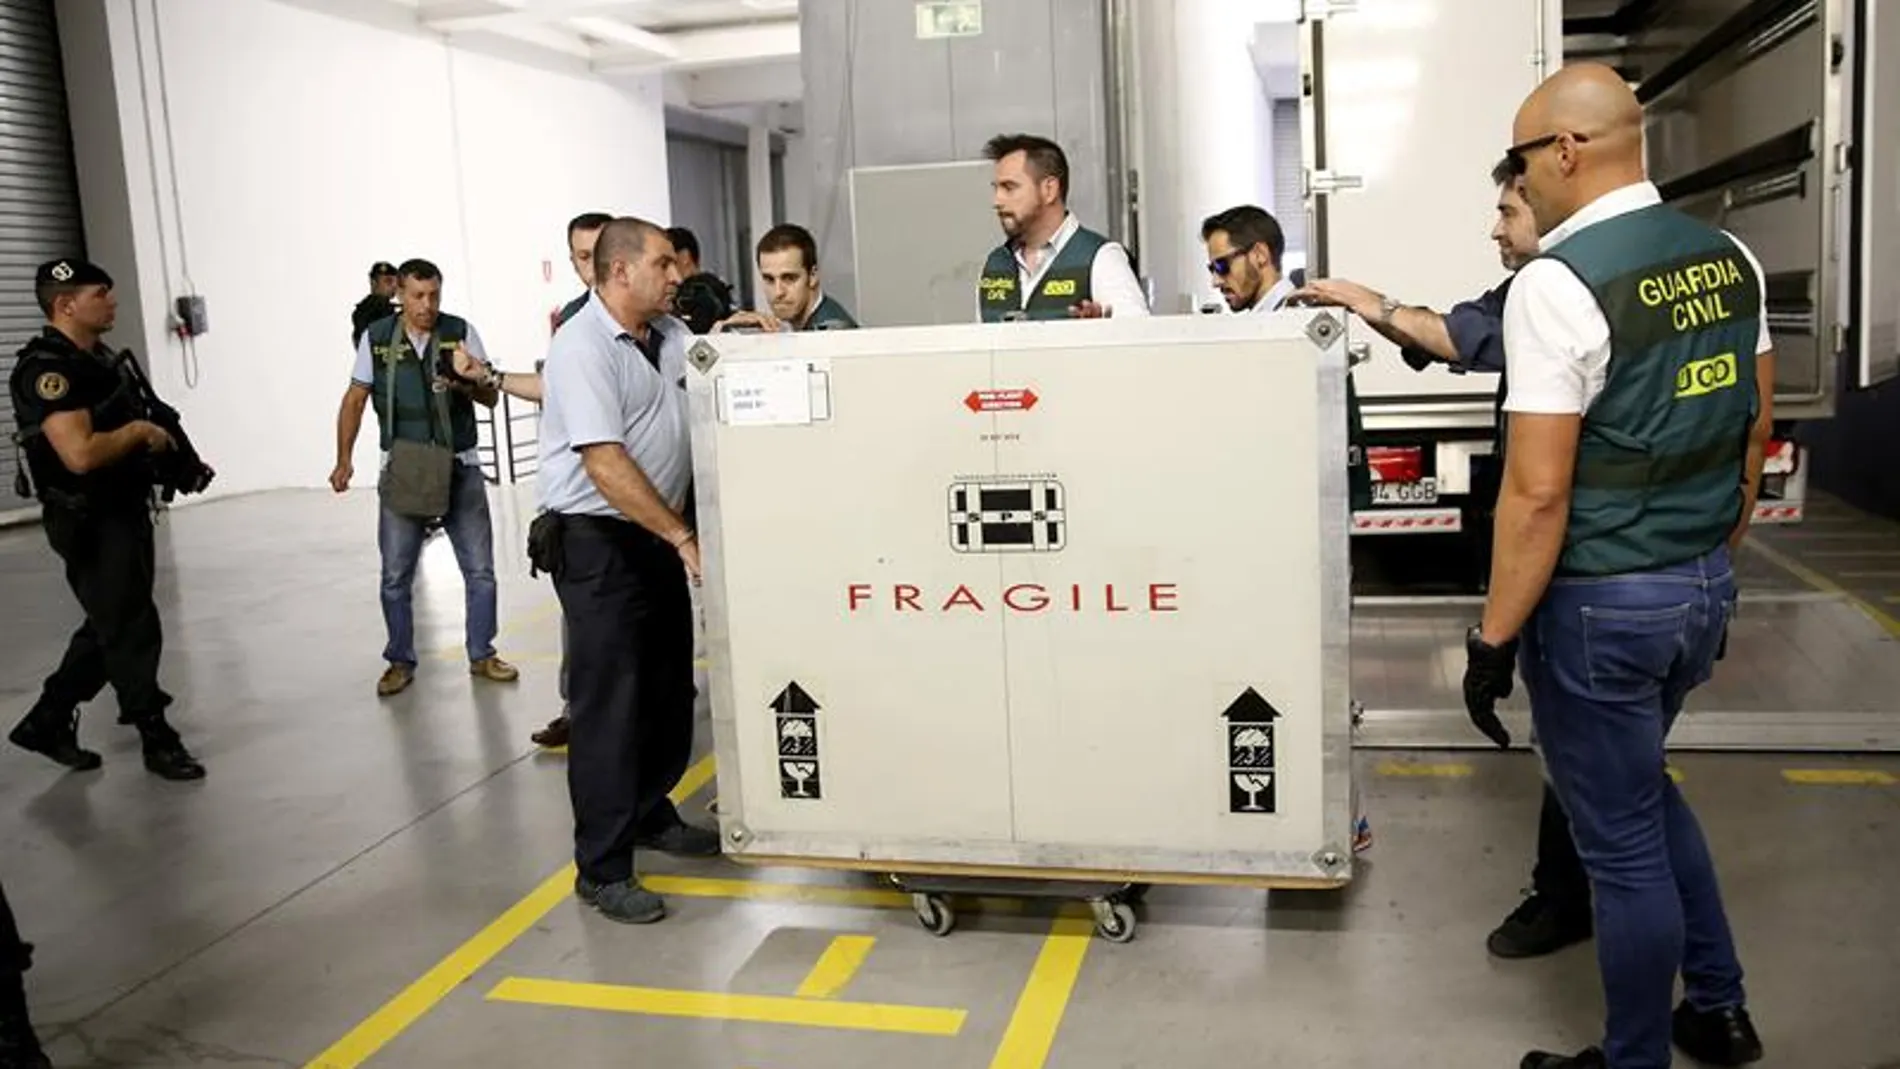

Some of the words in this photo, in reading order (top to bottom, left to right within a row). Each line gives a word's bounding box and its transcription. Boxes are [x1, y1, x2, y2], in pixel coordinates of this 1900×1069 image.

[1638, 257, 1744, 307] GUARDIA
[1672, 293, 1731, 331] CIVIL
[848, 584, 1179, 612] FRAGILE
